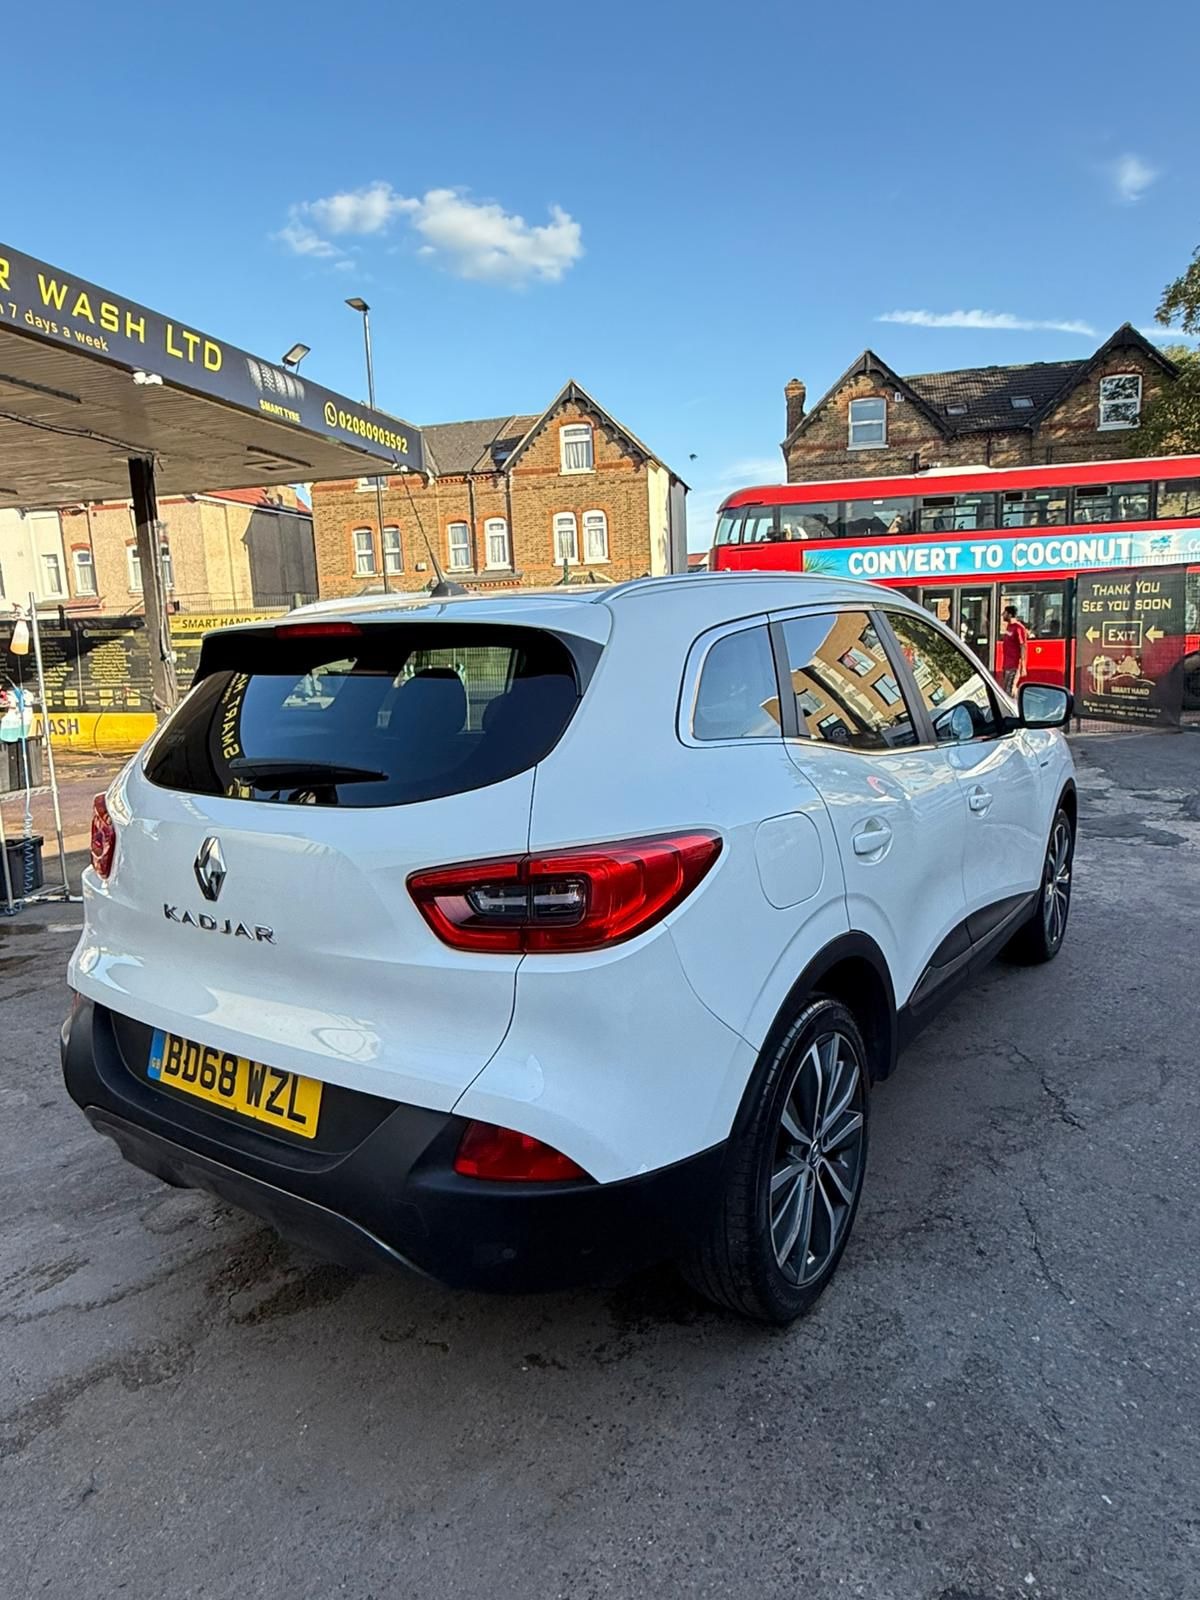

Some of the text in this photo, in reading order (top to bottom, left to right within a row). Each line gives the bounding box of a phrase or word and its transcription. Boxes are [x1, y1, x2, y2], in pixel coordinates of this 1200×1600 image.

[8, 302, 17, 318] 7
[24, 309, 58, 334] days
[62, 326, 71, 338] a
[75, 331, 109, 352] week
[38, 274, 145, 343] WASH
[166, 324, 222, 372] LTD
[259, 399, 301, 423] SMART TYRE
[339, 411, 408, 454] 02080903592
[848, 538, 1133, 576] CONVERT TO COCONUT
[1082, 598, 1172, 612] SEE YOU SOON
[1092, 581, 1160, 596] THANK YOU
[182, 618, 218, 629] SMART
[1108, 629, 1136, 641] EXIT
[163, 903, 277, 945] KADJAR
[164, 1034, 307, 1126] BD68 WZL
